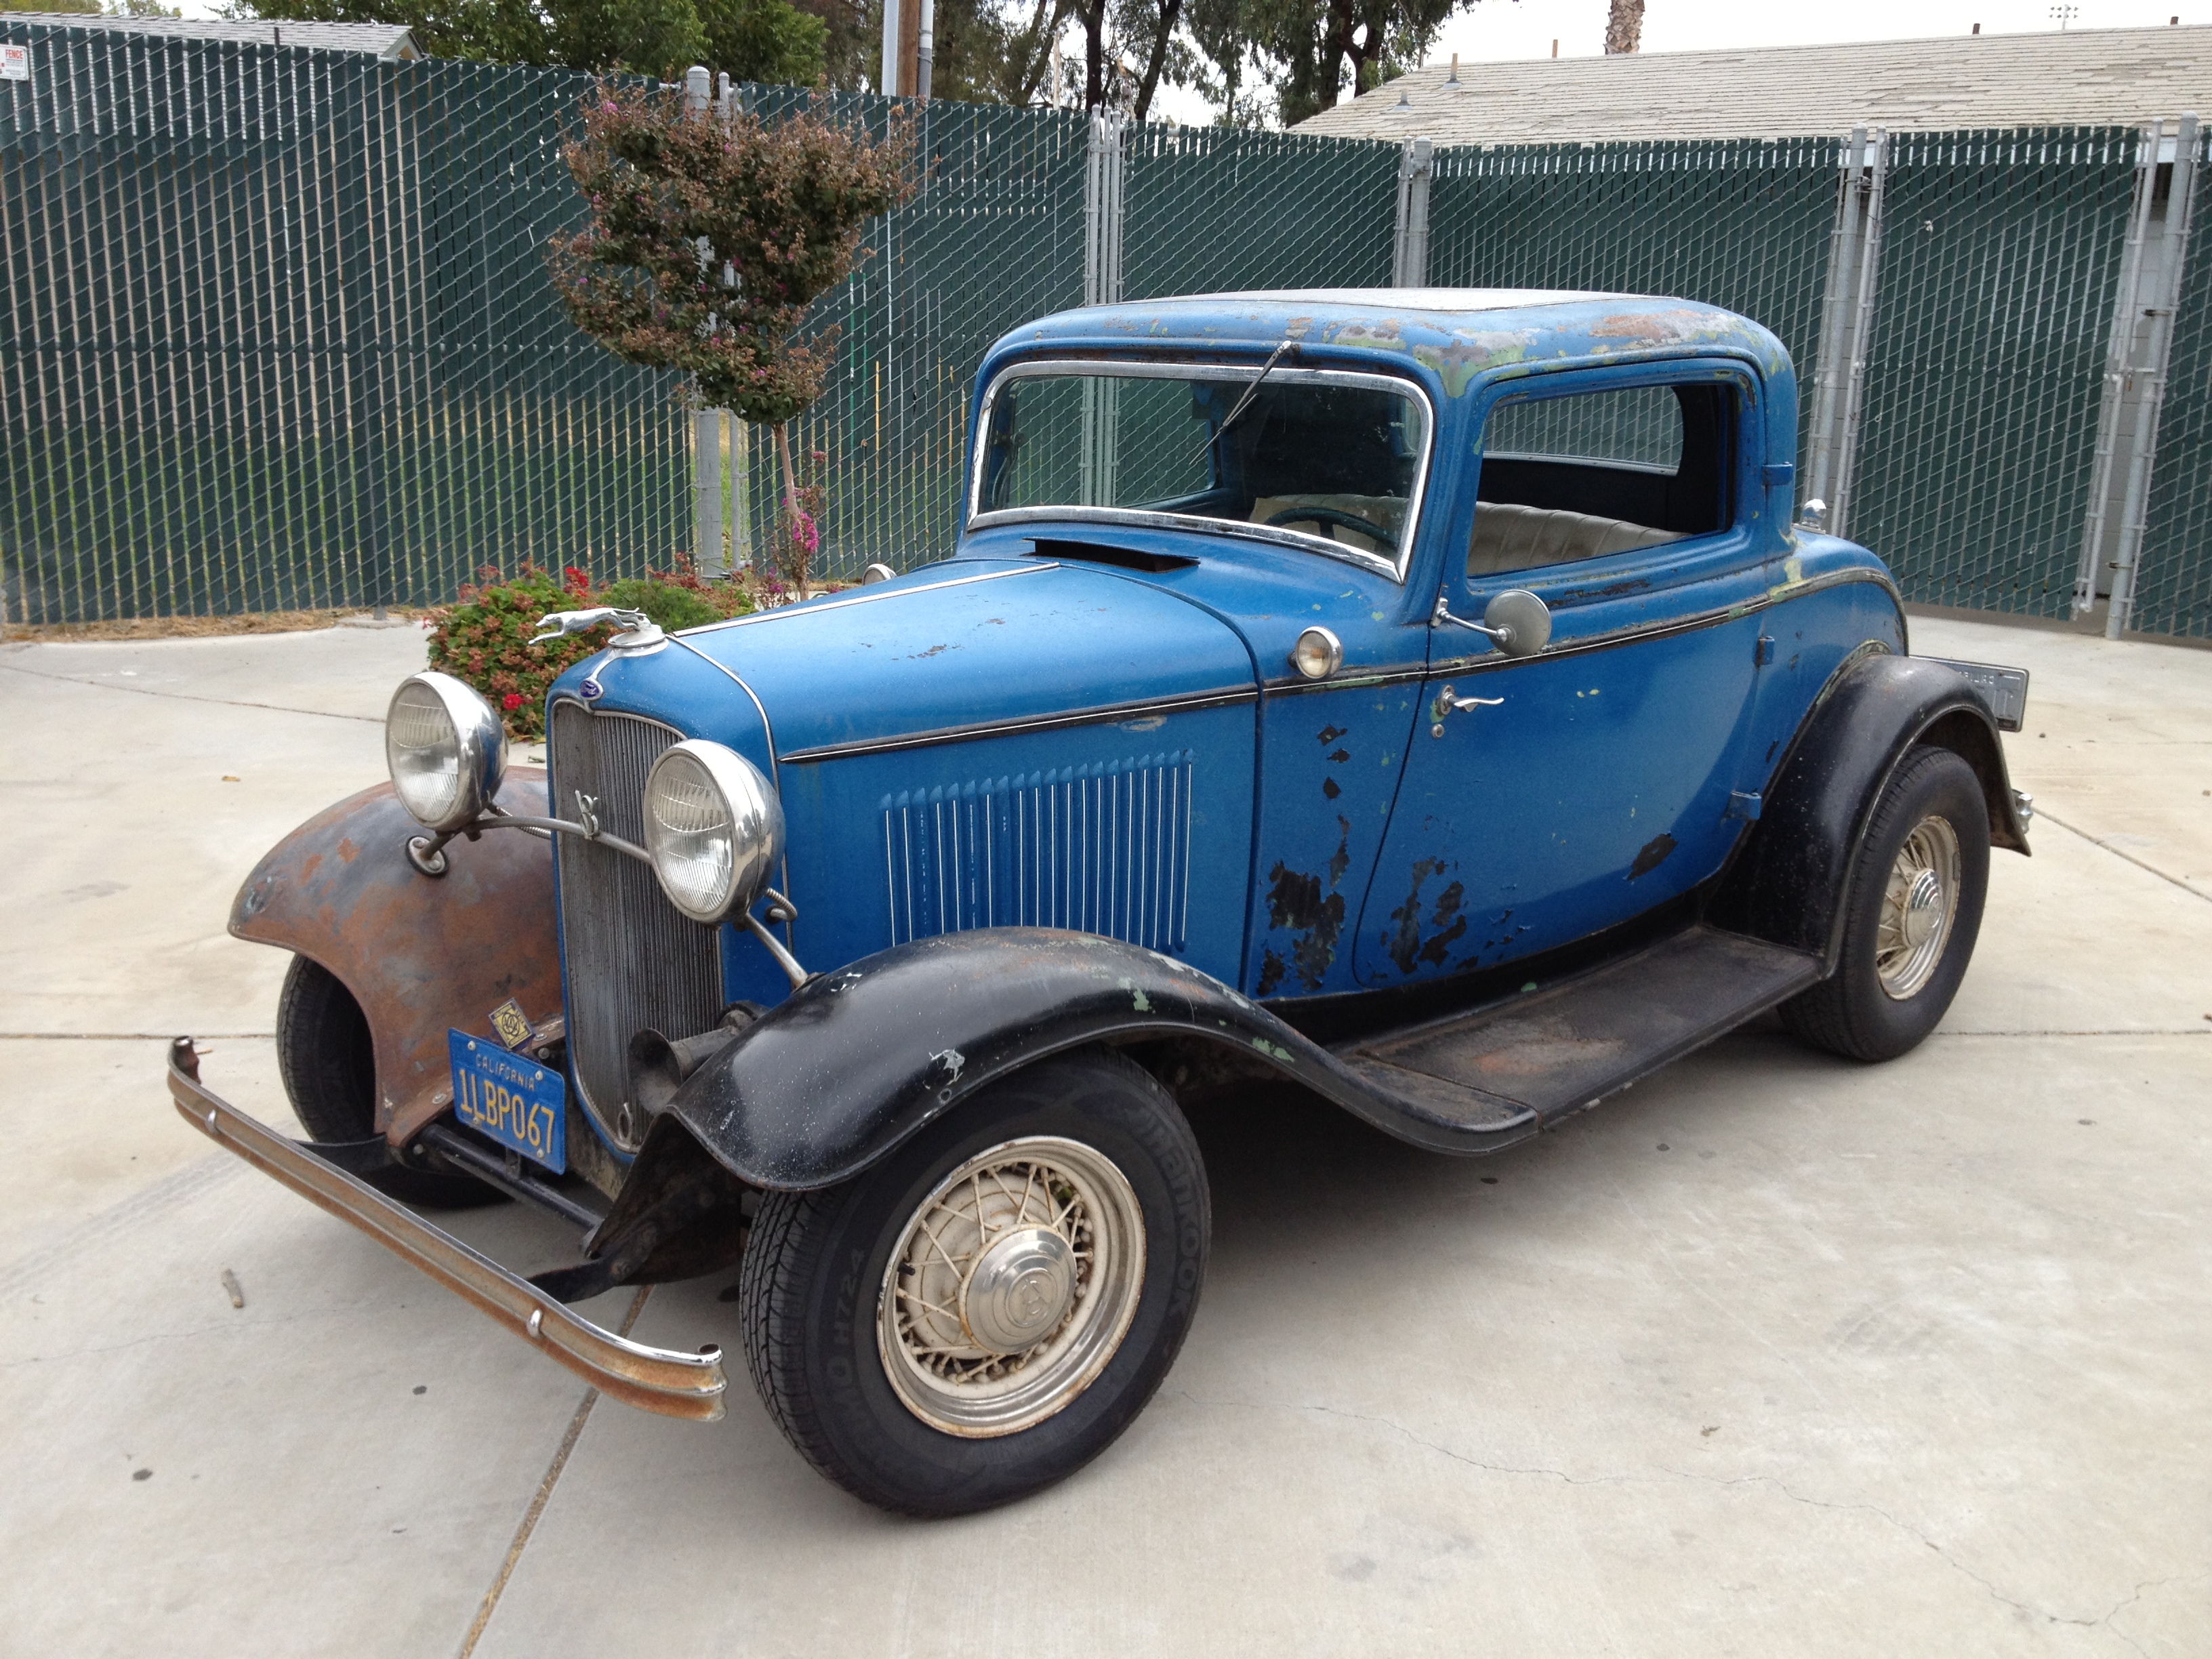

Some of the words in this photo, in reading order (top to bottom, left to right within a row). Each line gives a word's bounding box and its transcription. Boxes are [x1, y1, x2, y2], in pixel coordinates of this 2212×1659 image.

[5, 49, 23, 60] FENCE
[476, 1054, 535, 1092] CALIFORNIA
[459, 1069, 554, 1154] 1LBP067
